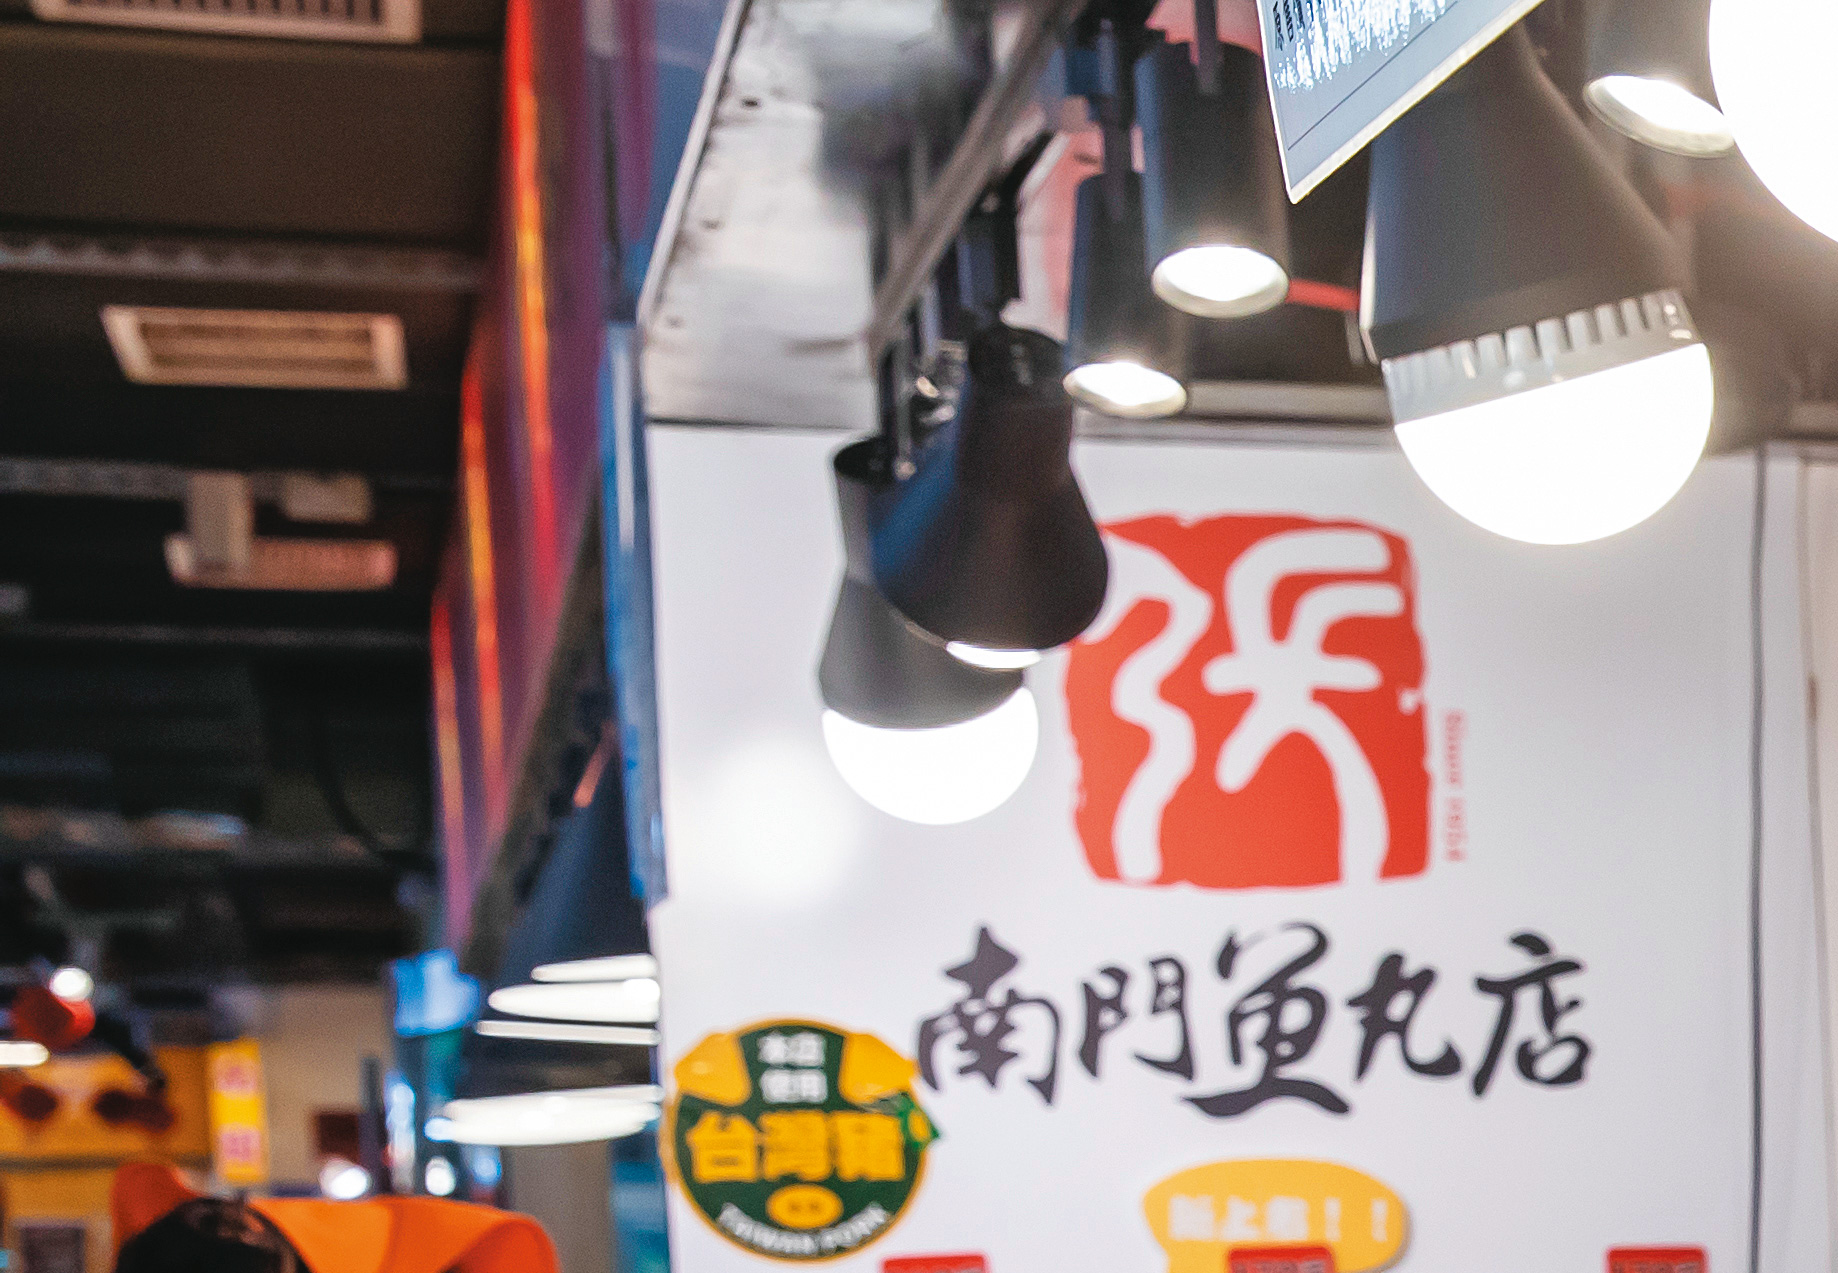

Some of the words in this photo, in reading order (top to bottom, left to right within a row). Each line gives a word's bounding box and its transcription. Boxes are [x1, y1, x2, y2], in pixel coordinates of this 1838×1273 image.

[917, 920, 1591, 1119] 南門魚丸店
